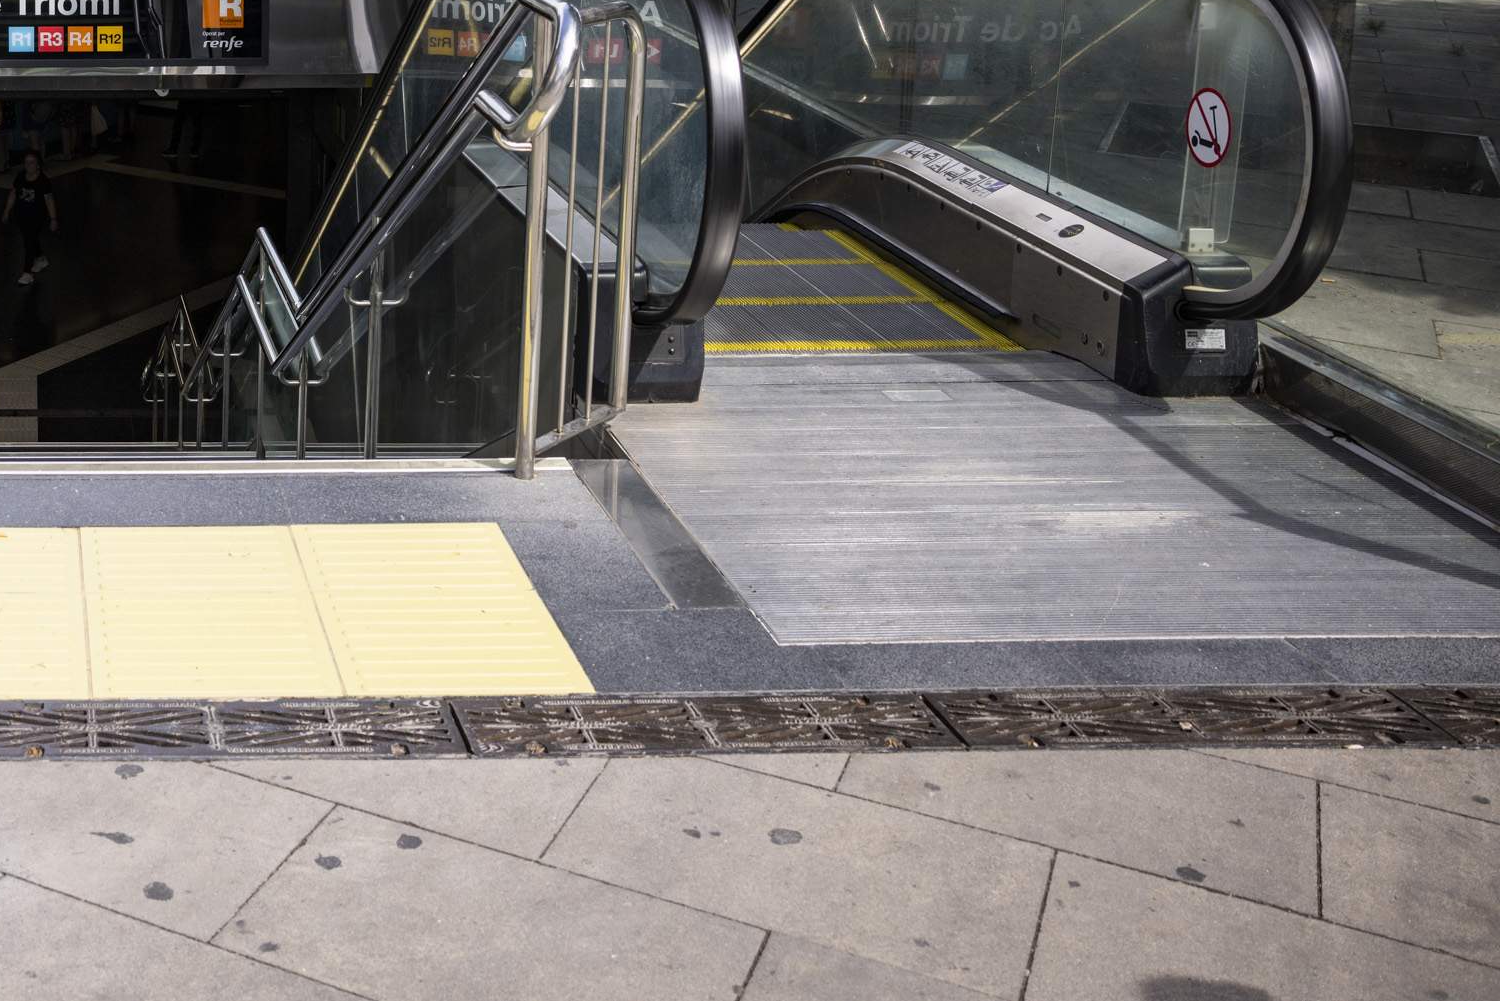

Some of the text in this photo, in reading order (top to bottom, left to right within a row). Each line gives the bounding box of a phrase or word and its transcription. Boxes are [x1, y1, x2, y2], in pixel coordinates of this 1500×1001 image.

[11, 33, 122, 47] R1 R3 R4 R12
[203, 36, 244, 52] renfe
